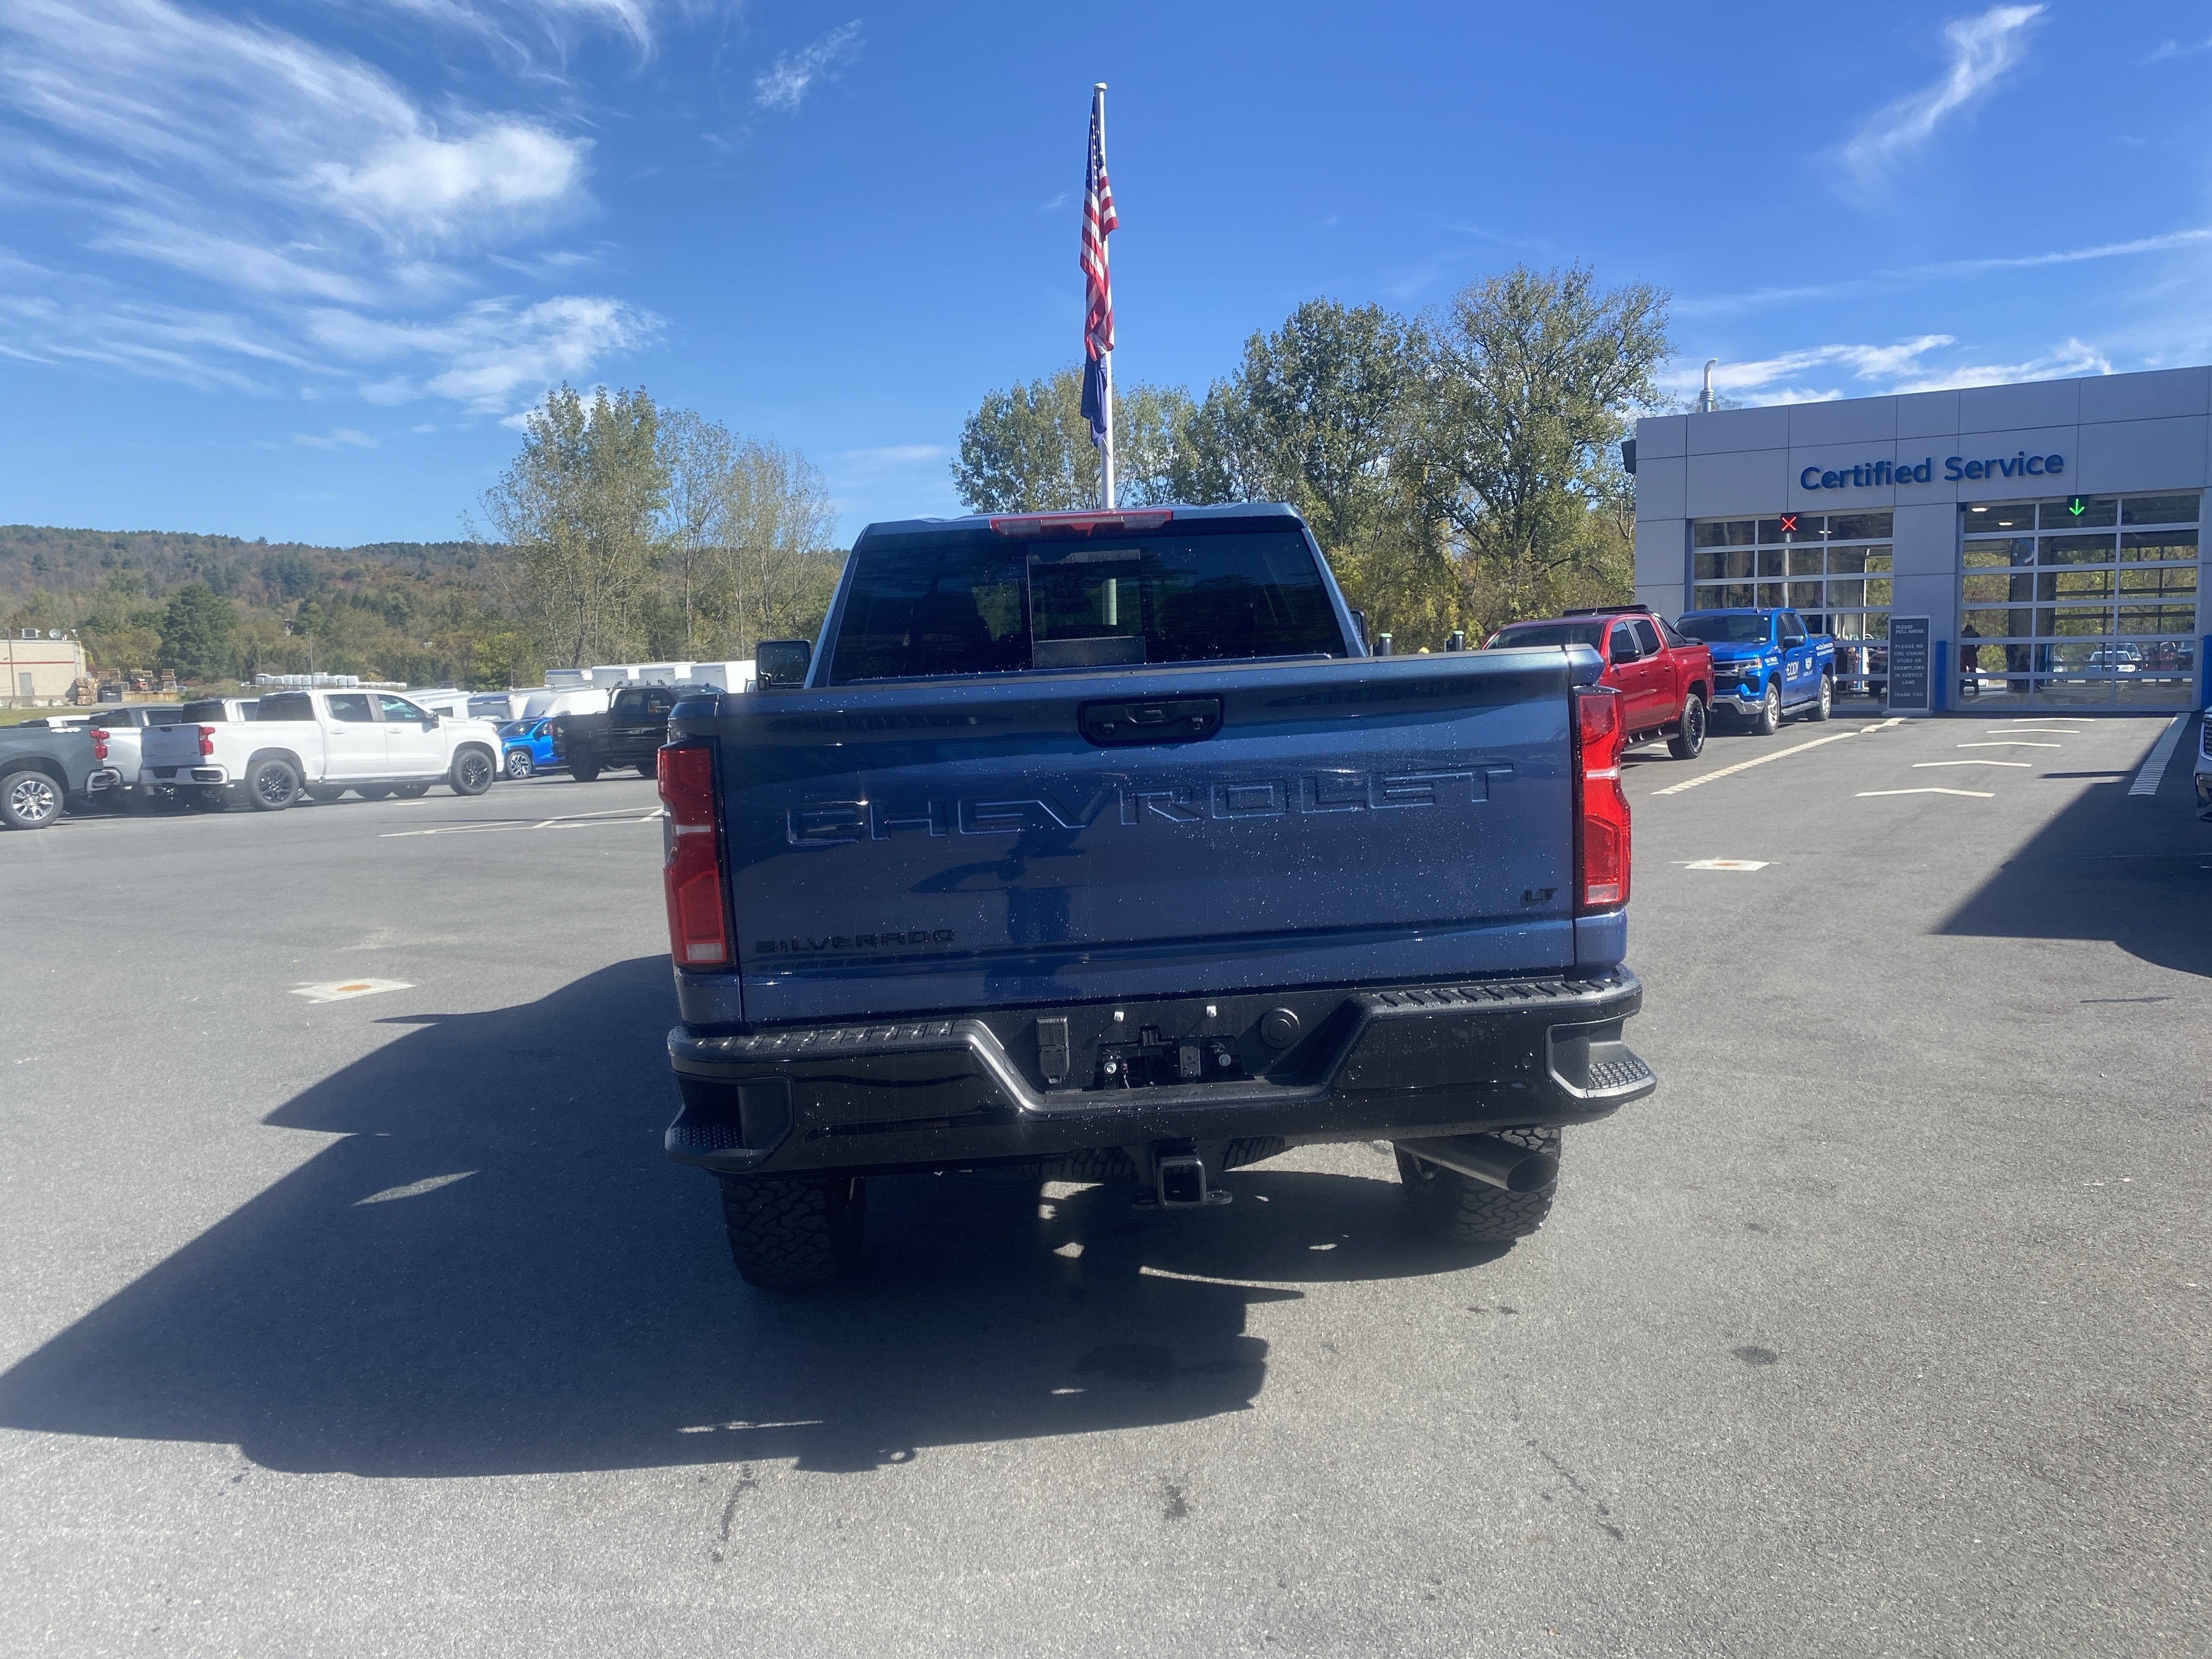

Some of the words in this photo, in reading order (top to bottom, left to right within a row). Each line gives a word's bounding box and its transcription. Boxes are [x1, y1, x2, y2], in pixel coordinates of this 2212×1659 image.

[1800, 457, 1932, 491] Certified
[1944, 450, 2064, 482] Service
[1786, 661, 1799, 676] CODY
[786, 763, 1514, 847] CHEVROLET
[1519, 887, 1559, 907] LT
[755, 929, 956, 953] SILVERADO
